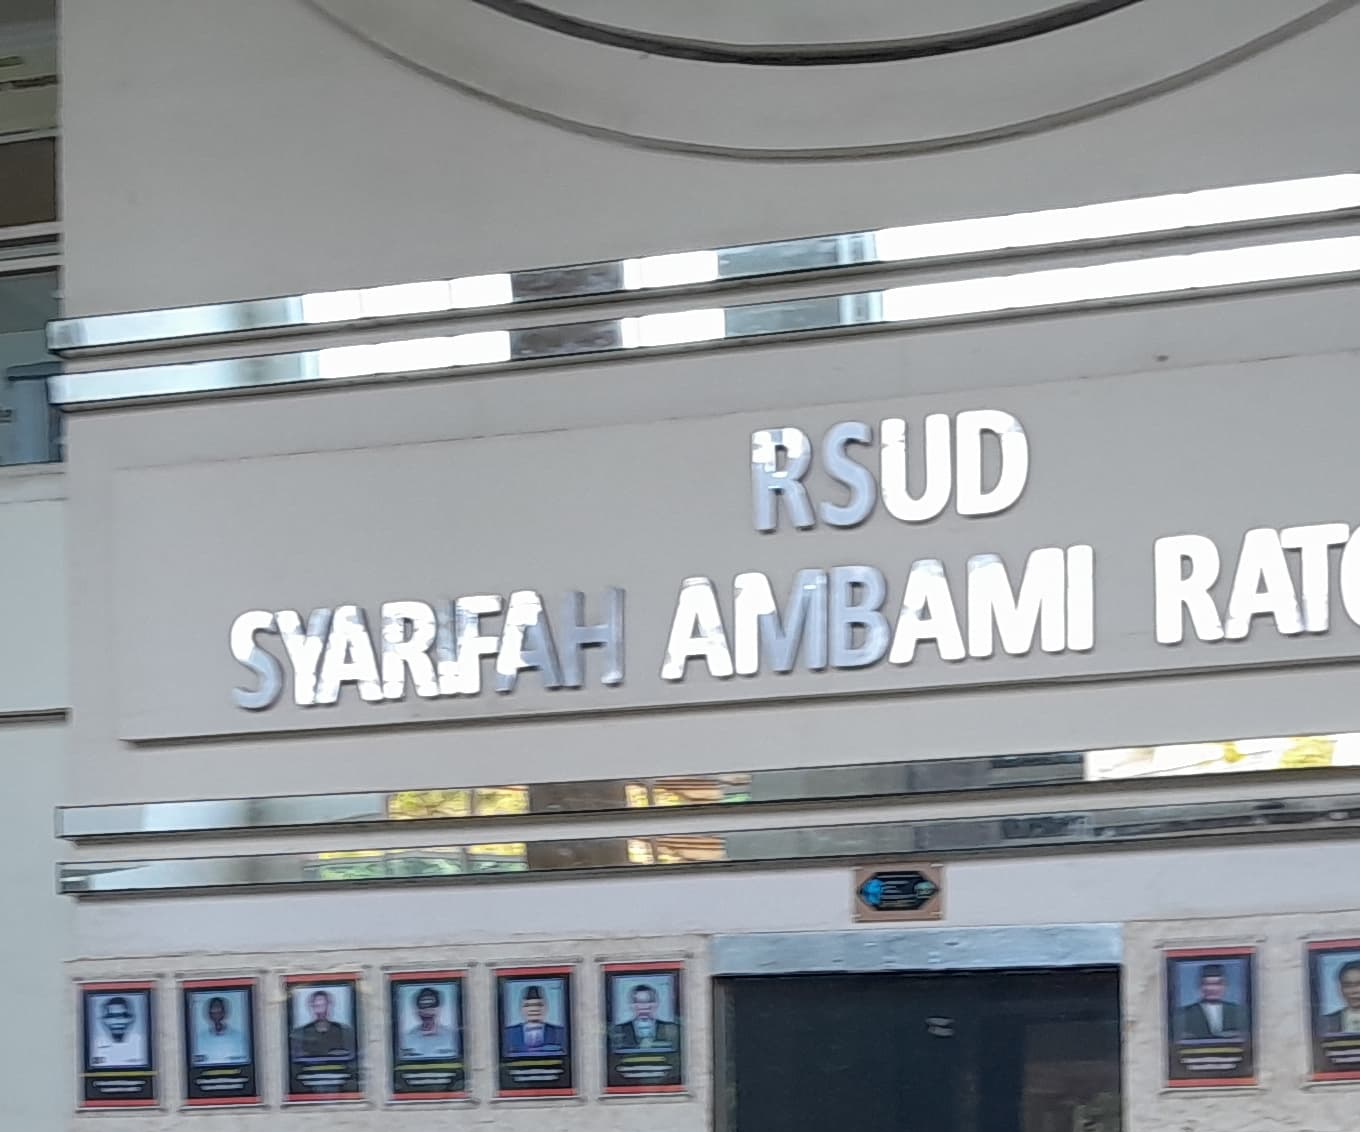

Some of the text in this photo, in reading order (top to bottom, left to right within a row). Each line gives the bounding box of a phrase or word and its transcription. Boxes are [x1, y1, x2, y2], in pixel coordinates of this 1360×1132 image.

[750, 409, 1030, 531] RSUD
[230, 586, 626, 711] SYARIFAH
[660, 544, 1095, 680] AMBAMI
